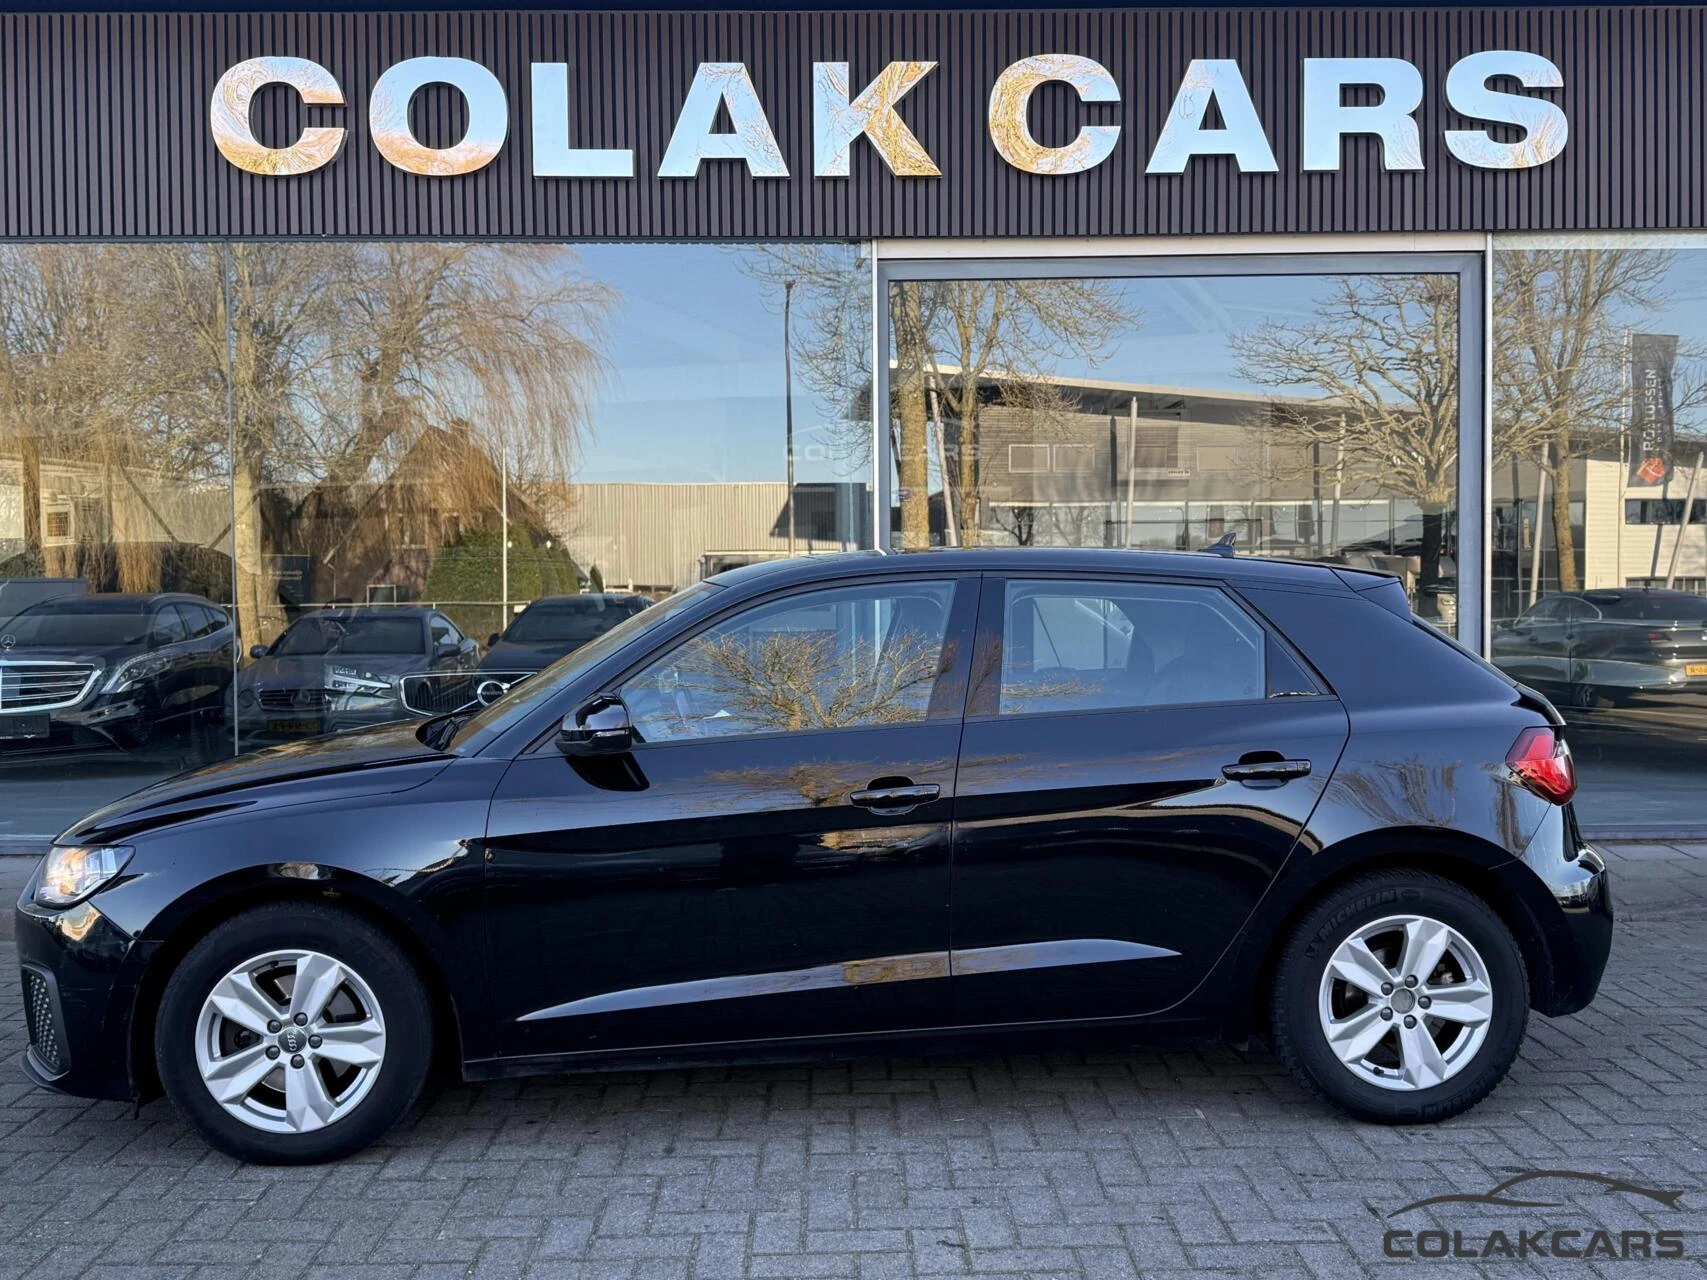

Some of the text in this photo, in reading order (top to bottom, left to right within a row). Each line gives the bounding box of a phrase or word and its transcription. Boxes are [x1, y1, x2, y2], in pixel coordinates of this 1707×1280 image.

[210, 50, 1569, 179] COLAK CARS
[1317, 888, 1397, 941] MICHELIN
